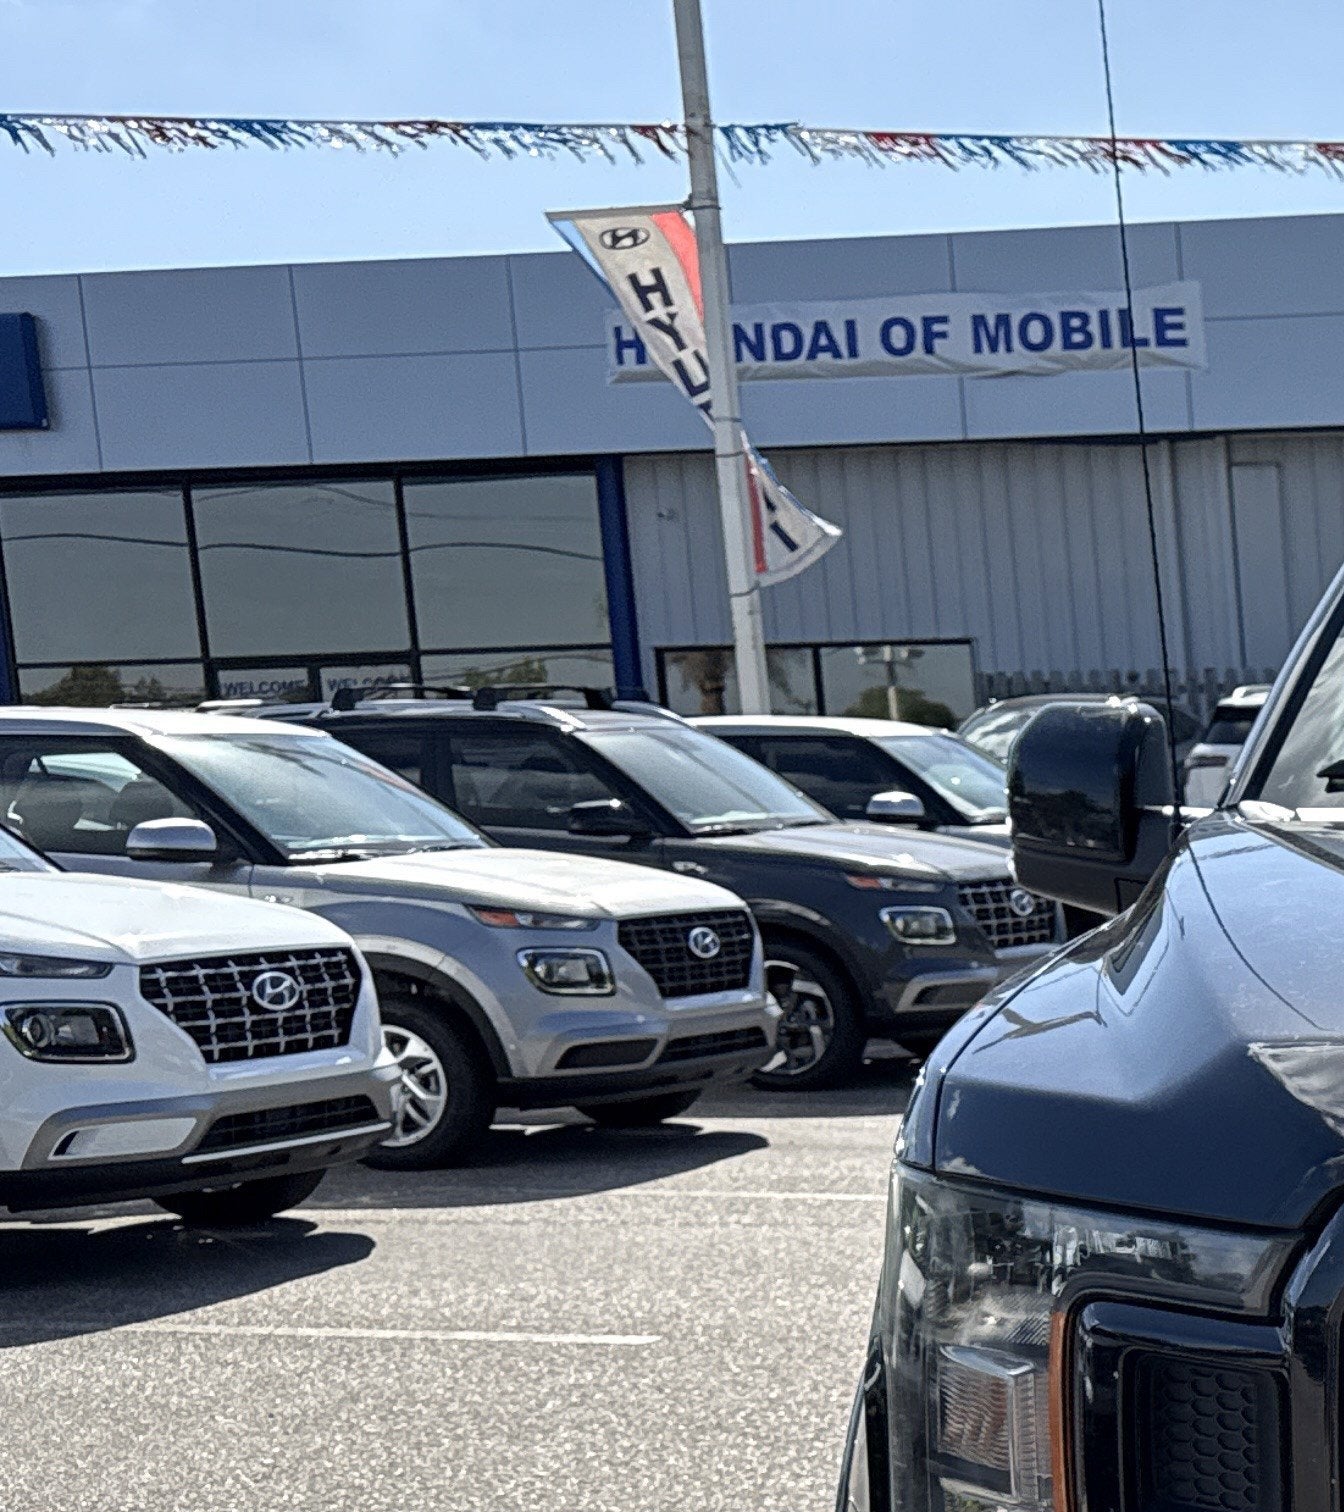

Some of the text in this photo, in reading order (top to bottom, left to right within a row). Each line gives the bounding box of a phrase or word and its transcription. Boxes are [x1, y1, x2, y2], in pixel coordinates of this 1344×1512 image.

[613, 307, 1188, 366] HNDAI OF MOBILE
